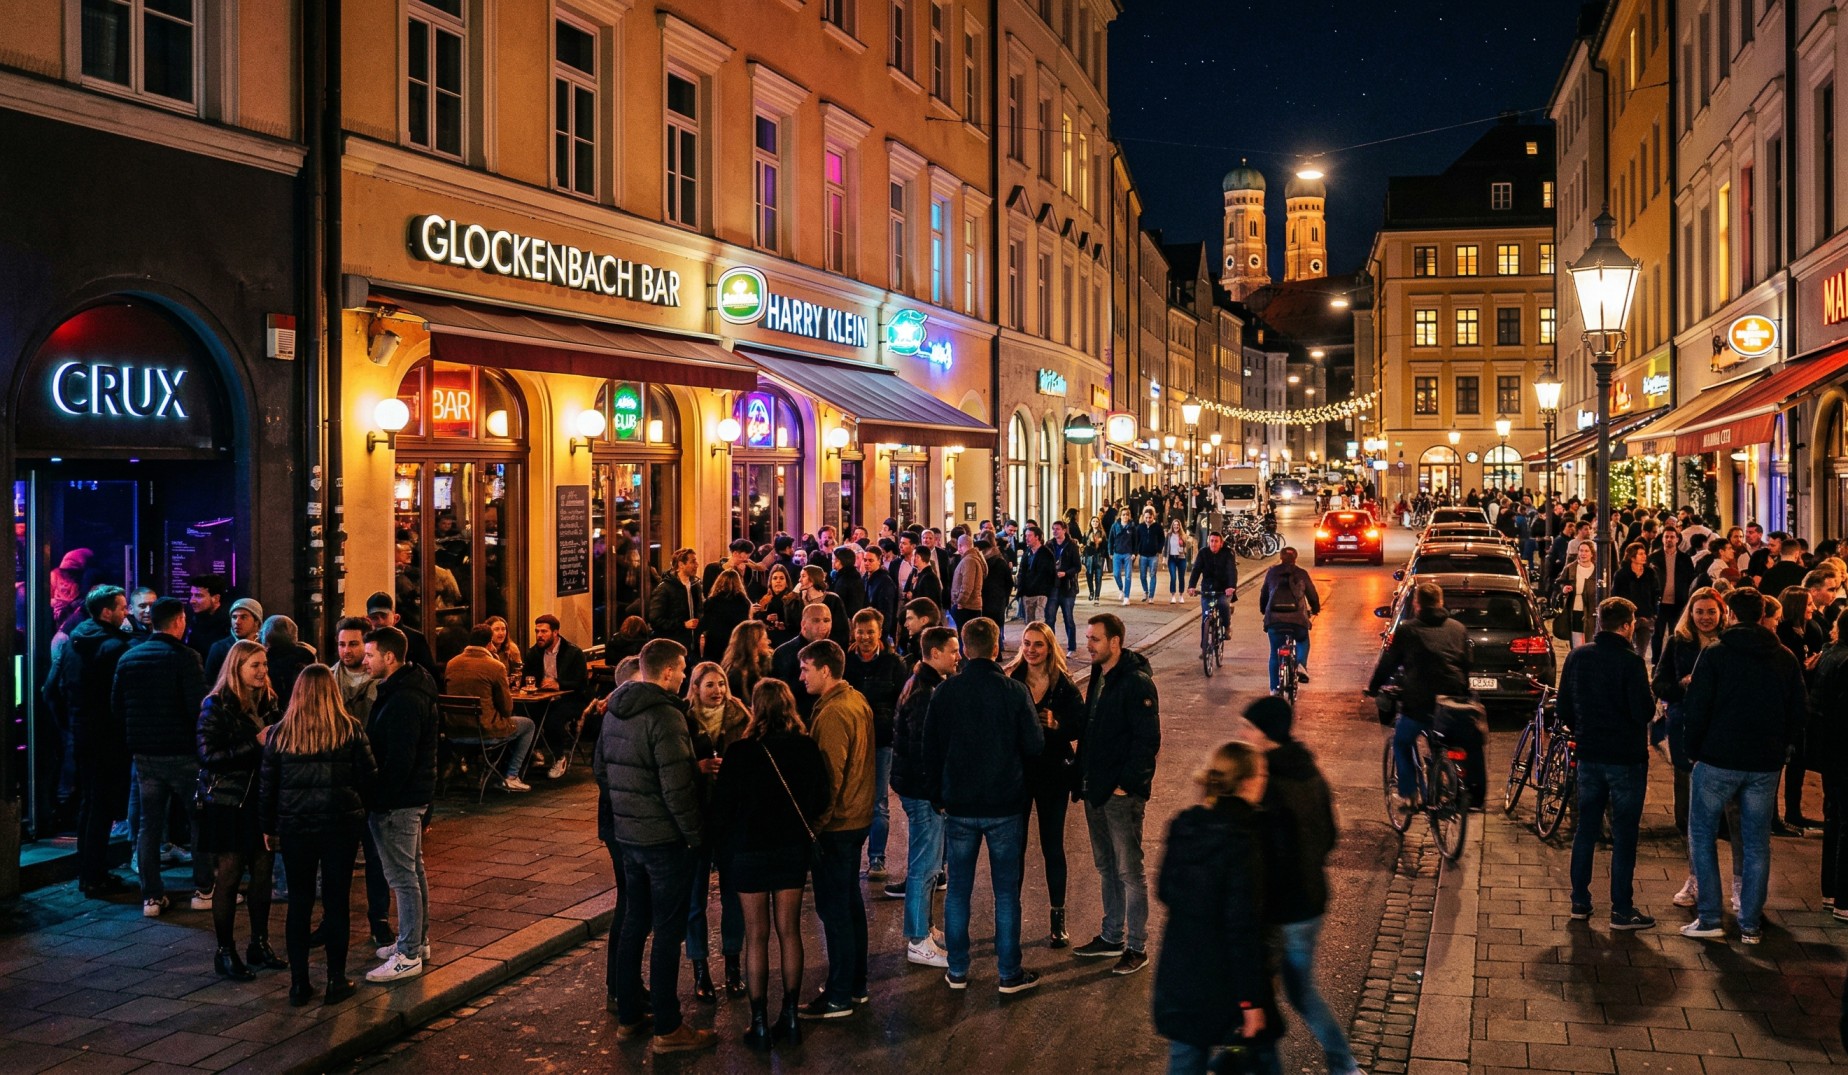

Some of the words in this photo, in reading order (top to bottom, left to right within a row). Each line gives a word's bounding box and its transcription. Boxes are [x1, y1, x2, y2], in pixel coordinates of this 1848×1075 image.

[422, 214, 634, 298] GLOCKENBACH
[641, 264, 682, 307] BAR
[767, 292, 823, 338] HARRY
[827, 308, 869, 347] KLEIN
[52, 361, 188, 418] CRUX
[432, 389, 471, 420] BAR
